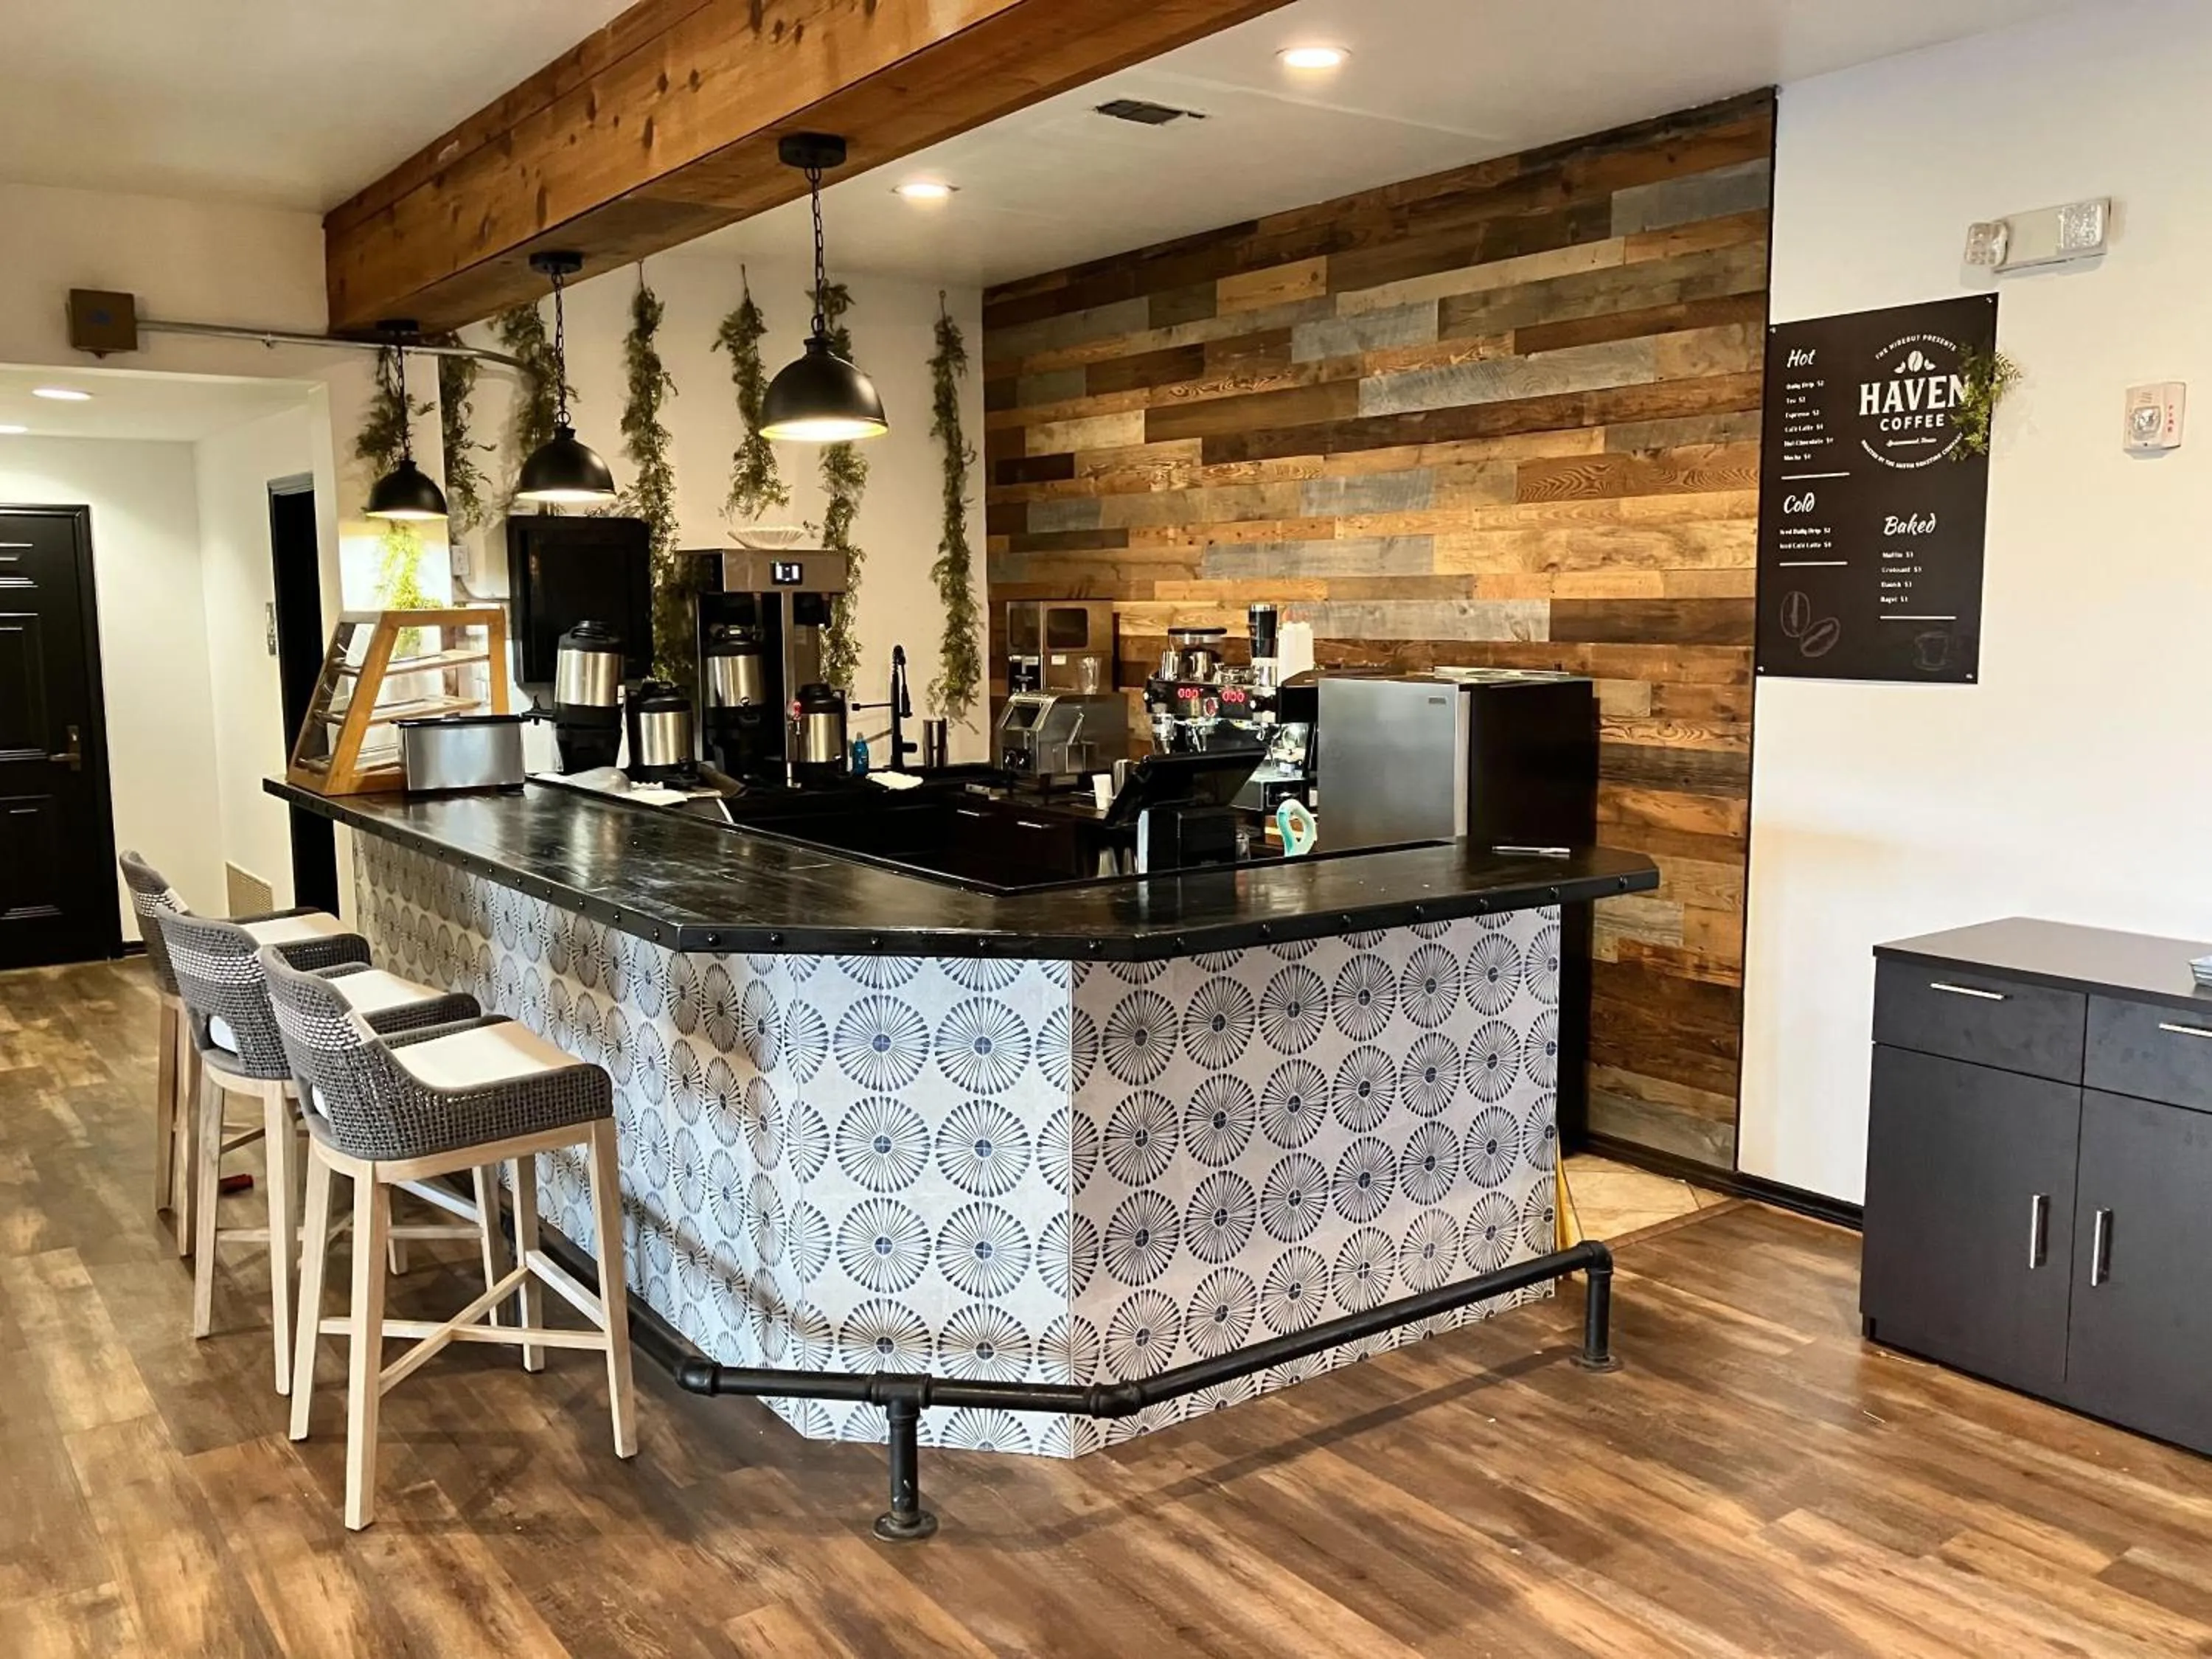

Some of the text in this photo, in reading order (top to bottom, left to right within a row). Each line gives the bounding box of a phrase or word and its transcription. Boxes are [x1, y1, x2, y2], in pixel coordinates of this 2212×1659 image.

[1787, 349, 1815, 368] Hot
[1859, 374, 1967, 416] HAVEN
[1879, 413, 1945, 431] COFFEE
[1784, 492, 1815, 514] Cold
[1883, 512, 1936, 536] Baked
